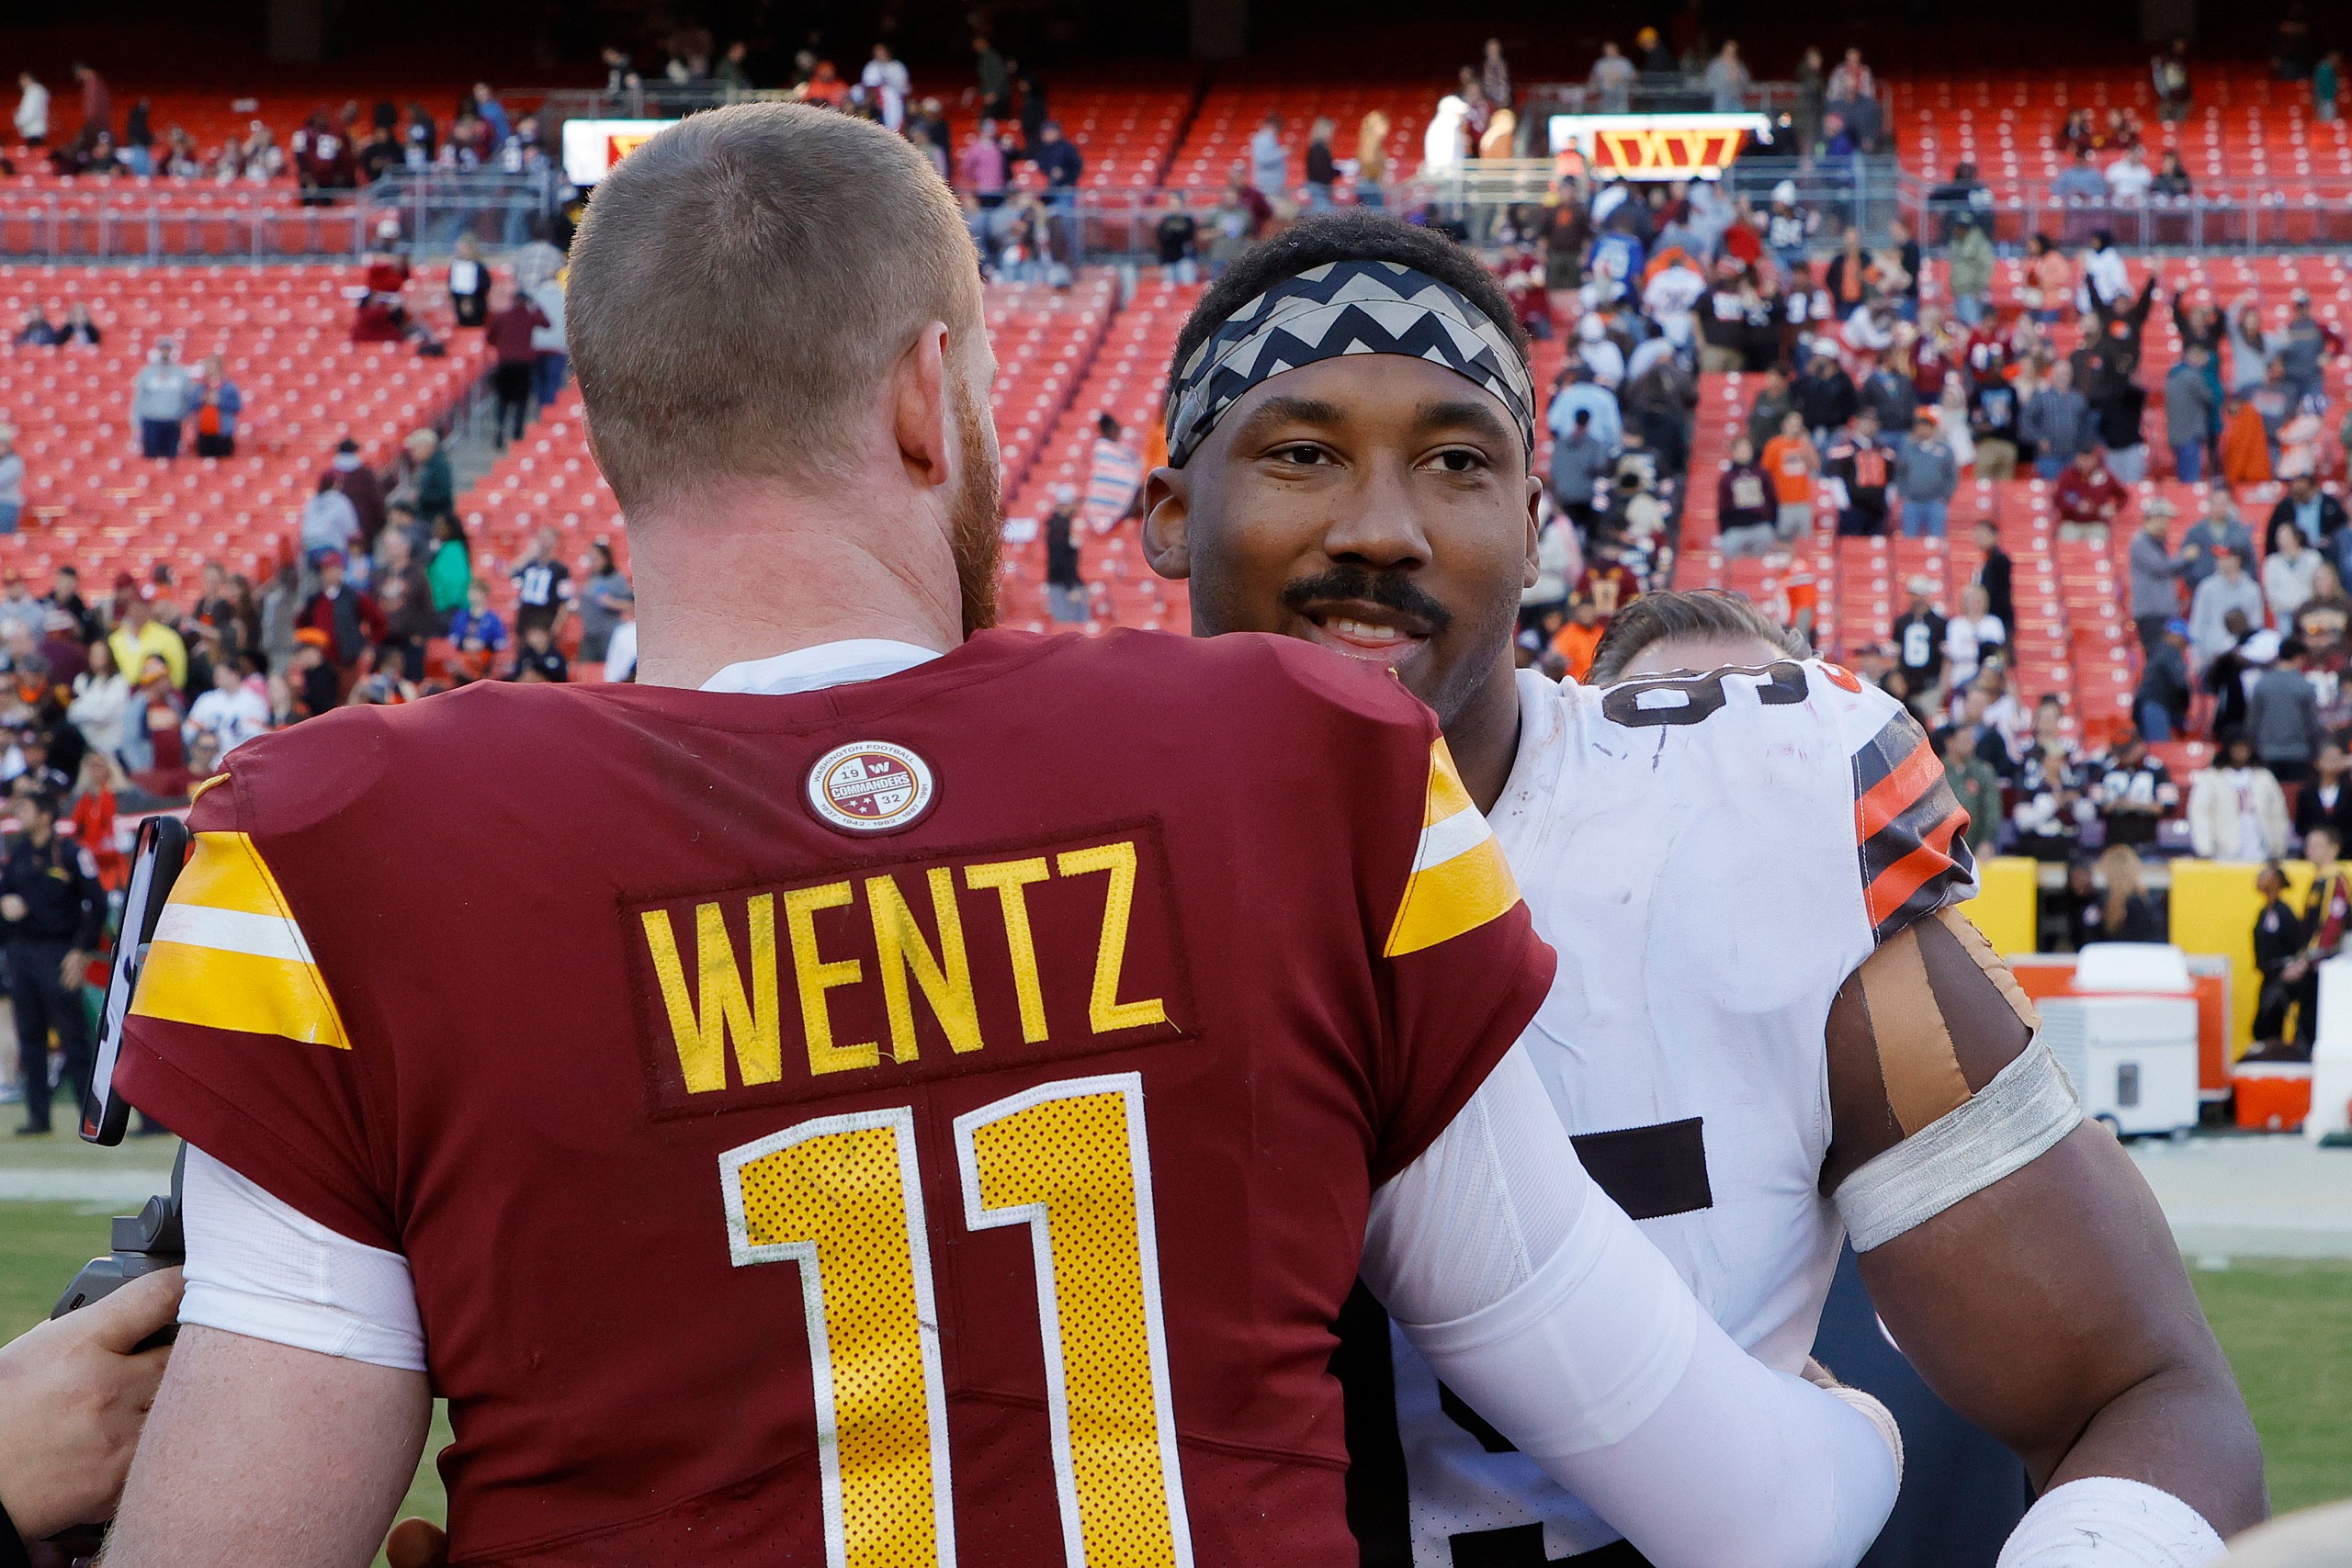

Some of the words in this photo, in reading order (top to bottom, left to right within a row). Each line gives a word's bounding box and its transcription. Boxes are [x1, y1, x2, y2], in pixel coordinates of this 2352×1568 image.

[1904, 622, 1930, 668] 6
[813, 744, 863, 783] WASHINGTON
[866, 744, 915, 764] FOOTBALL
[841, 769, 860, 780] 19
[831, 773, 910, 798] COMMANDERS
[882, 794, 902, 805] 32
[820, 803, 837, 818] 1937
[842, 818, 865, 827] 1942
[640, 841, 1165, 1094] WENTZ
[718, 1071, 1195, 1568] 11
